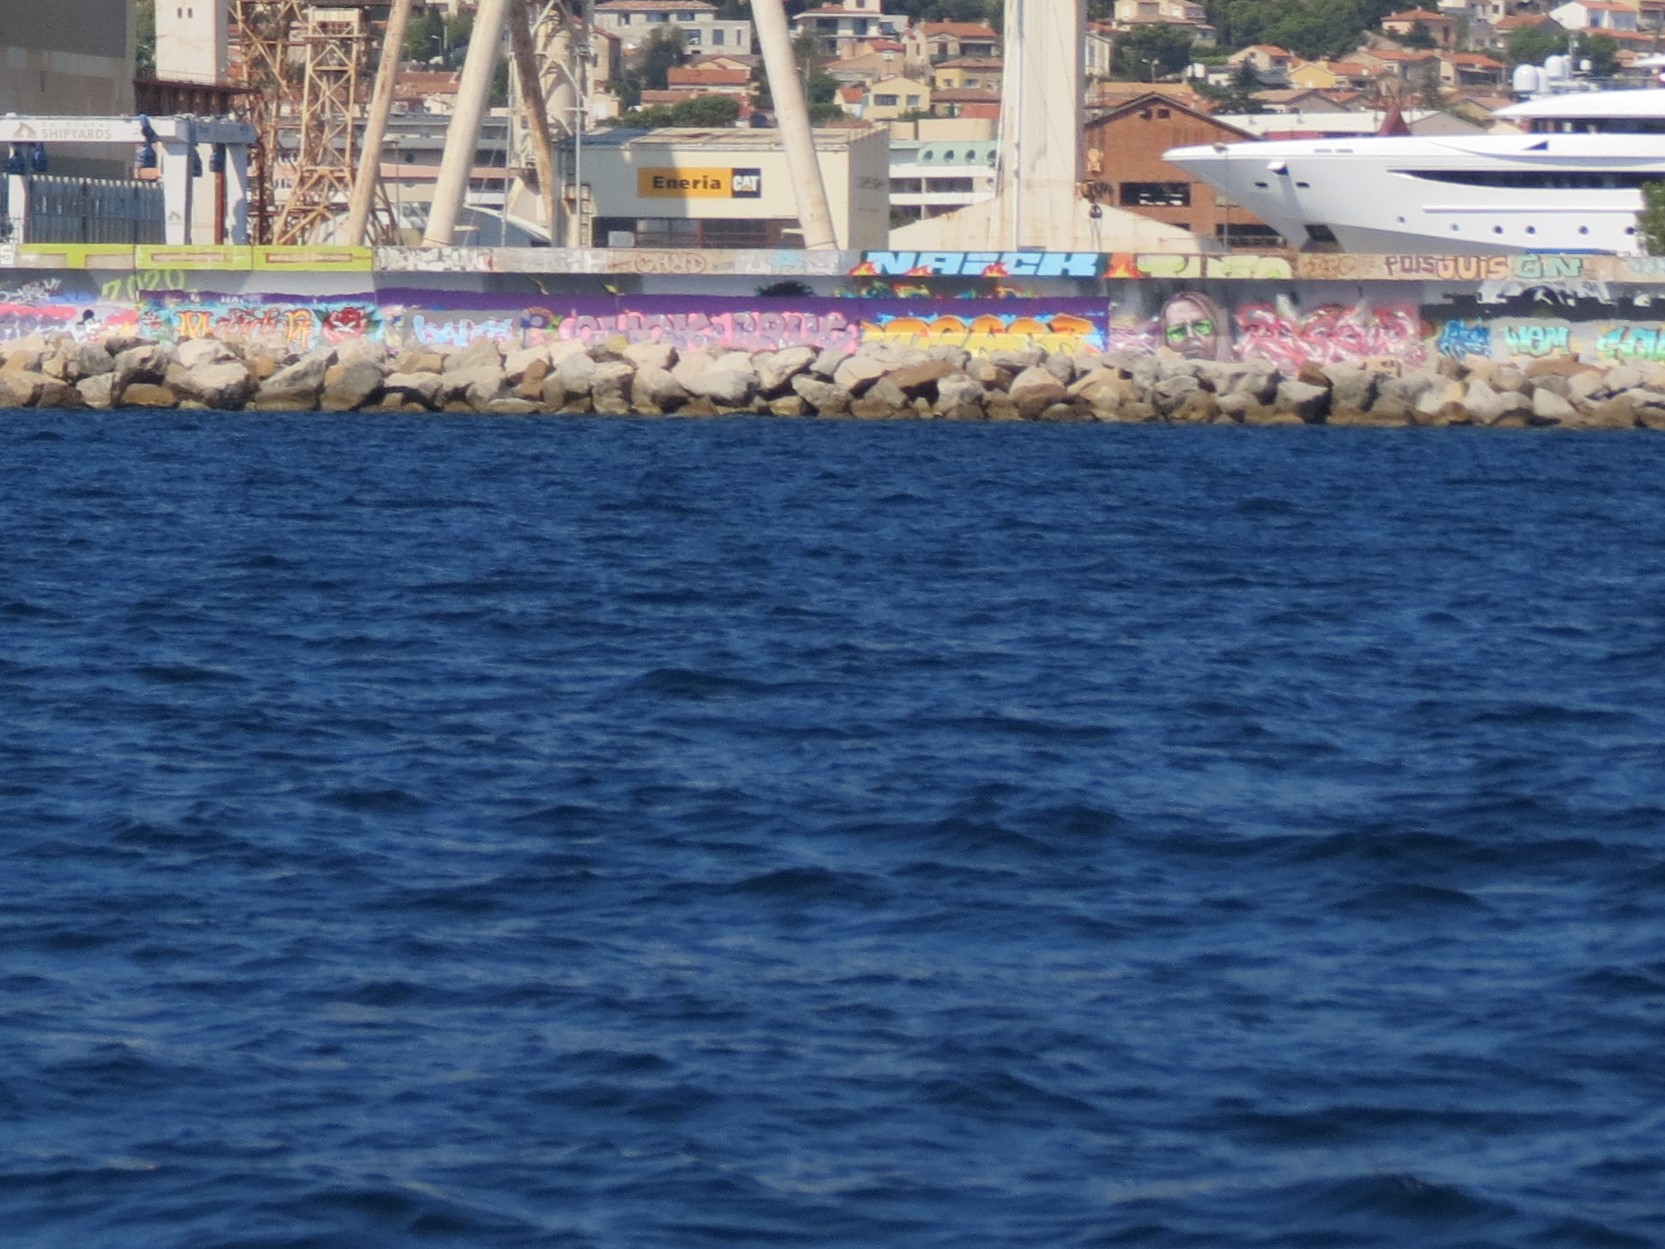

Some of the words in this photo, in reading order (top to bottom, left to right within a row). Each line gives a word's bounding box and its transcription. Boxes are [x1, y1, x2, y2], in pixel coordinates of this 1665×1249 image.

[42, 128, 112, 139] SHIPYARDS
[652, 175, 721, 189] Eneria
[733, 176, 759, 192] CAT
